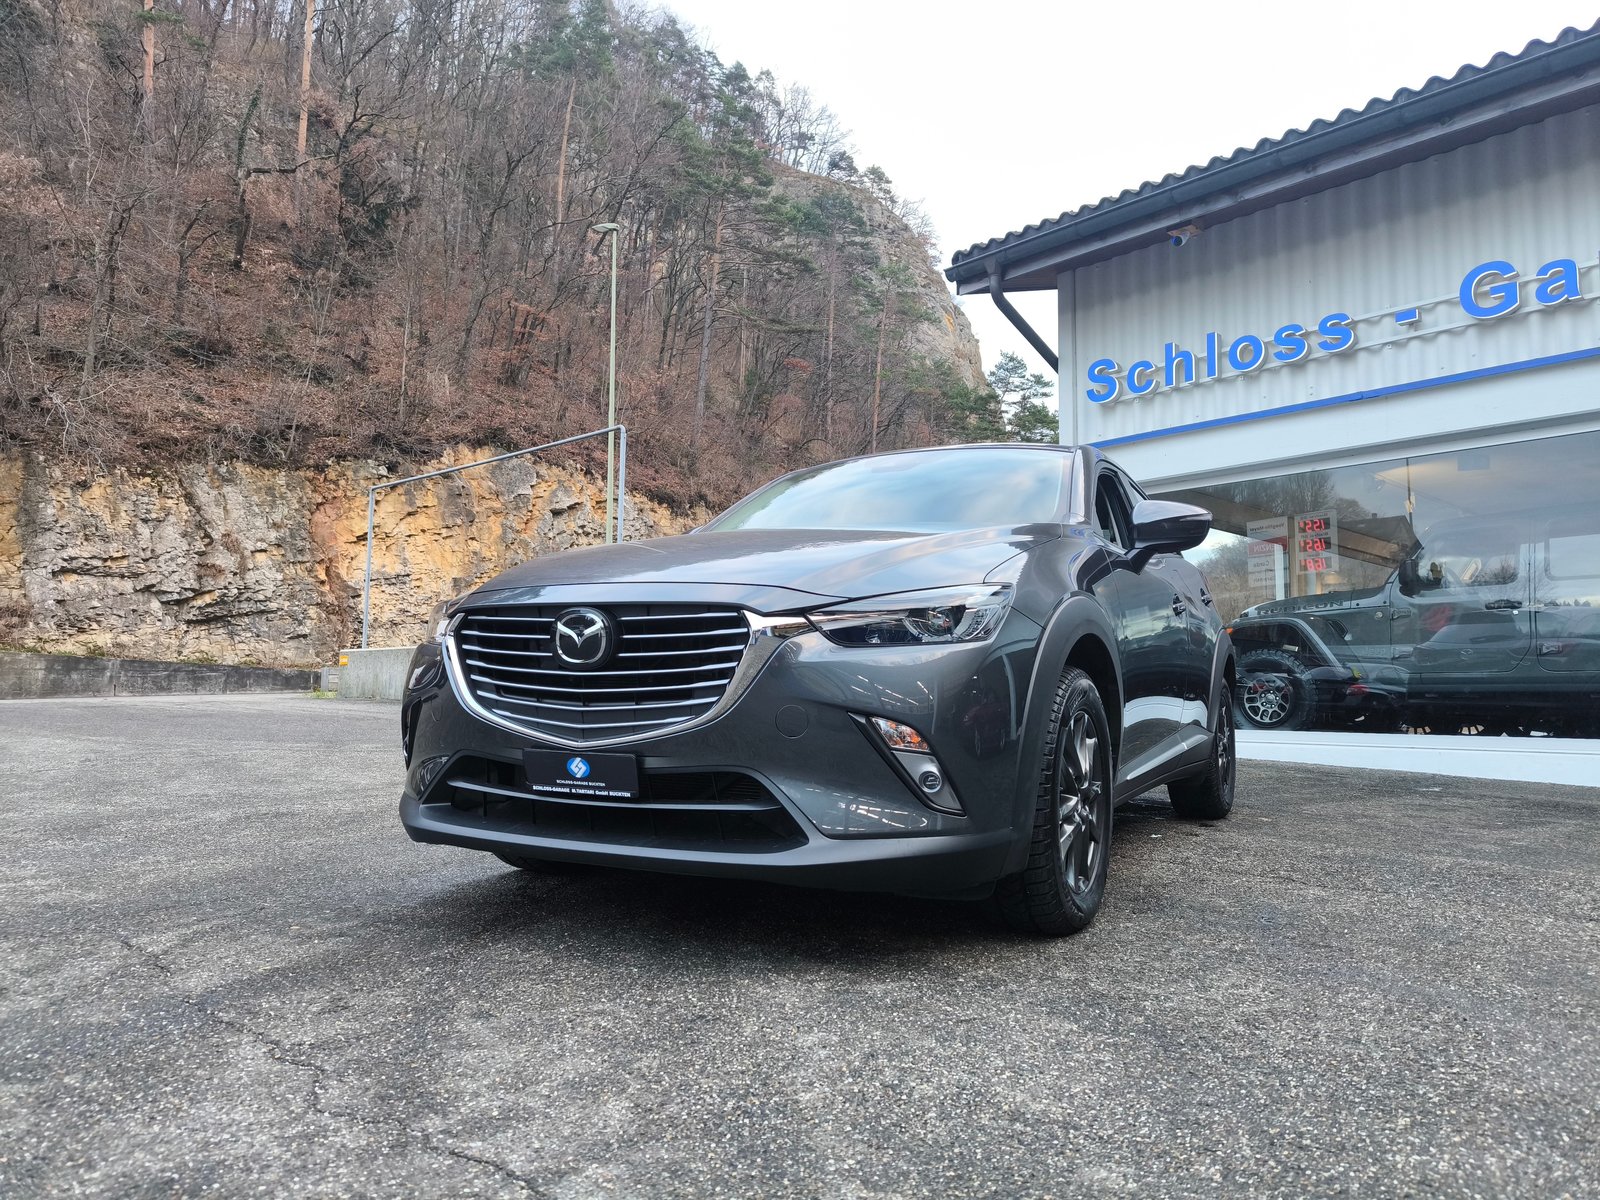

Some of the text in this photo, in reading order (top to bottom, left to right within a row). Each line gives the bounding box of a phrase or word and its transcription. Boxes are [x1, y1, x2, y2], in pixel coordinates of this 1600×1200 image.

[1086, 312, 1355, 404] Schloss
[1459, 256, 1600, 319] Ga
[1256, 600, 1344, 615] RUBICON
[532, 785, 570, 793] SCHLOSS-GARAGE
